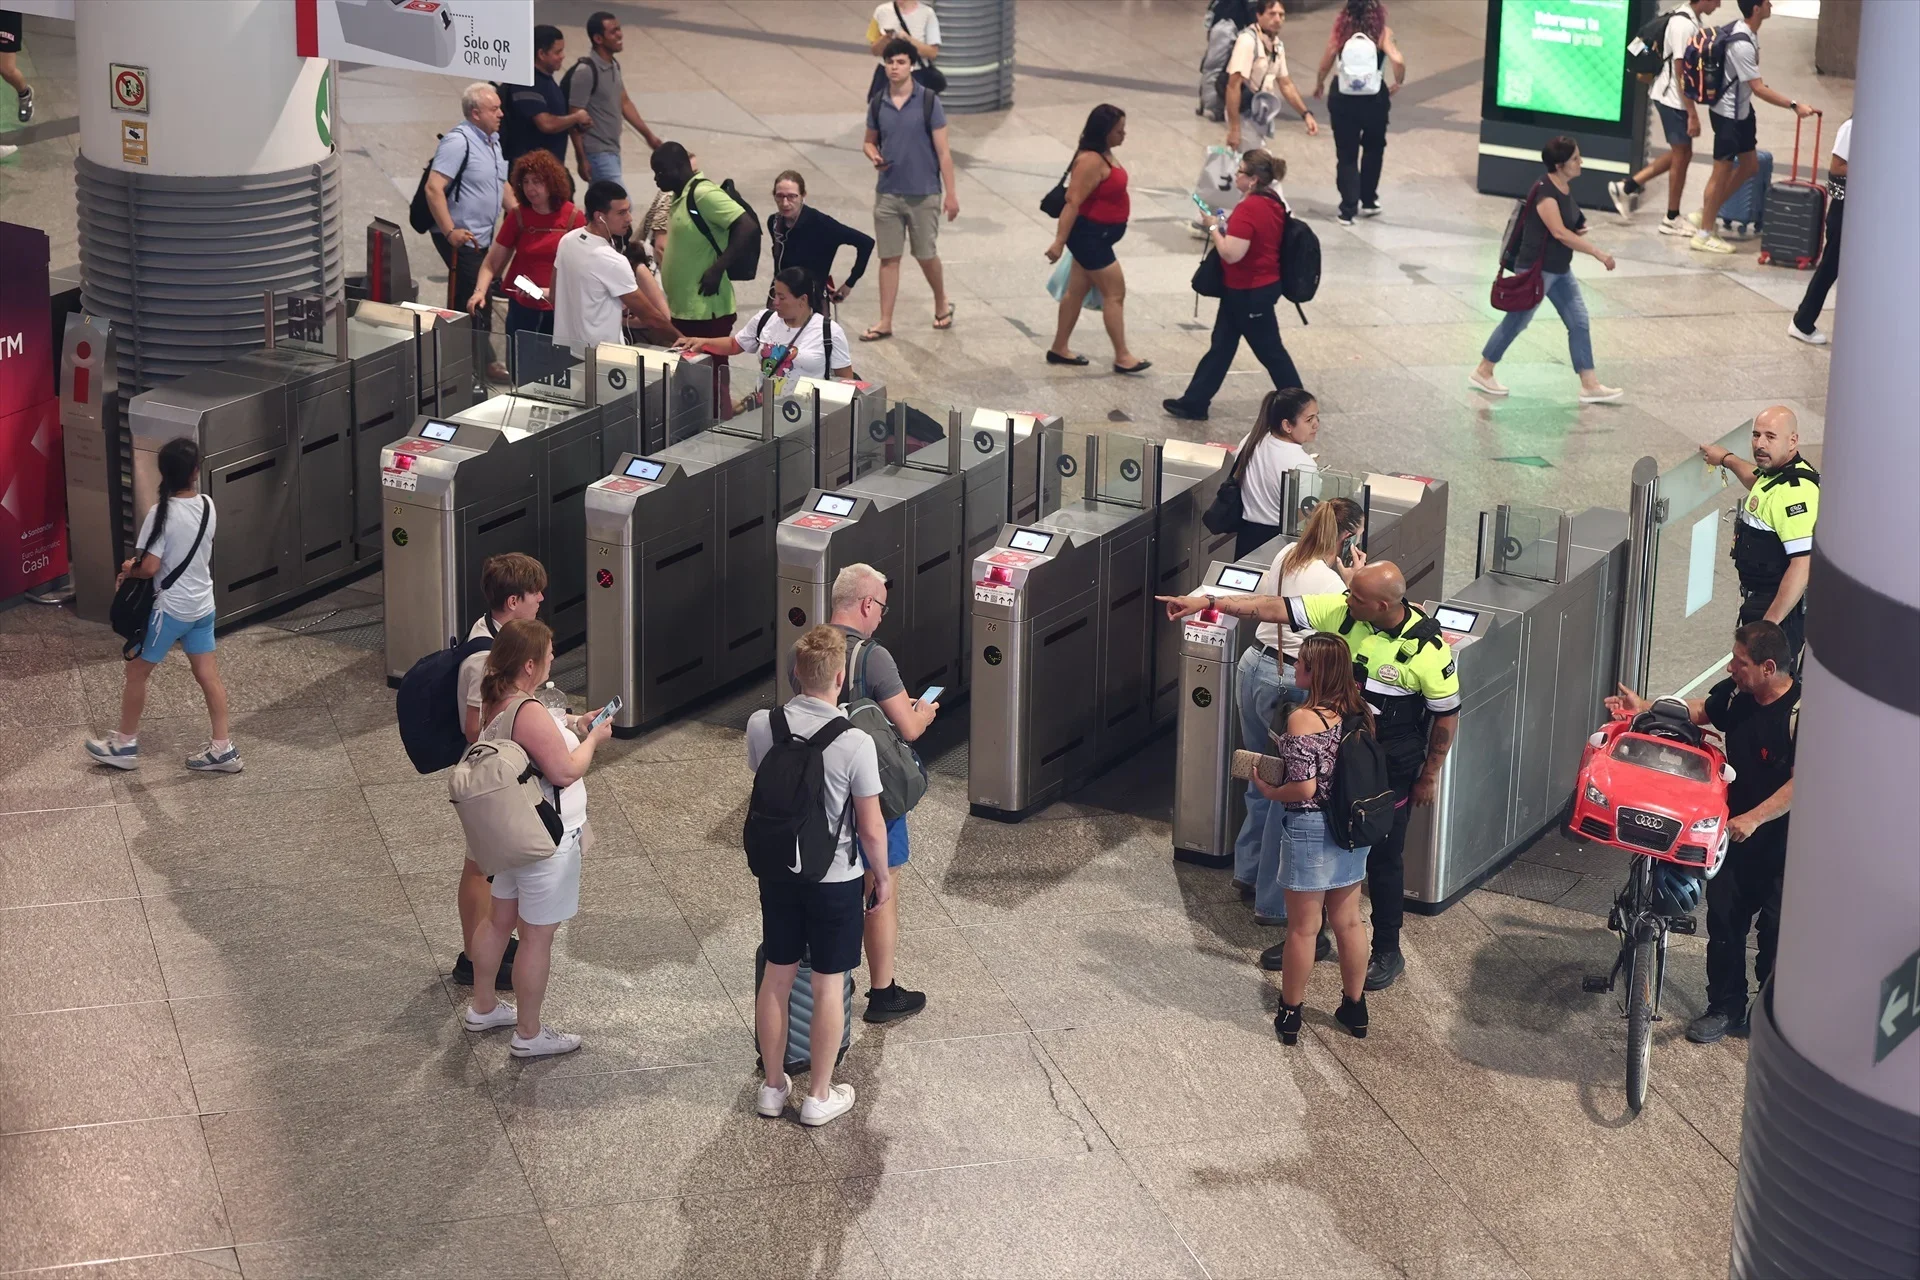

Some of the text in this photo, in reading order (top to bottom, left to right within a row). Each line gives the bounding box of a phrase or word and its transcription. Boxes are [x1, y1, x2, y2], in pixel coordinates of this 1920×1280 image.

[463, 35, 511, 54] Solo QR
[463, 50, 508, 71] QR only
[393, 506, 403, 515] 23
[598, 547, 609, 556] 24
[22, 554, 50, 574] Cash
[791, 585, 801, 595] 25
[987, 622, 997, 632] 26
[1196, 664, 1208, 673] 27
